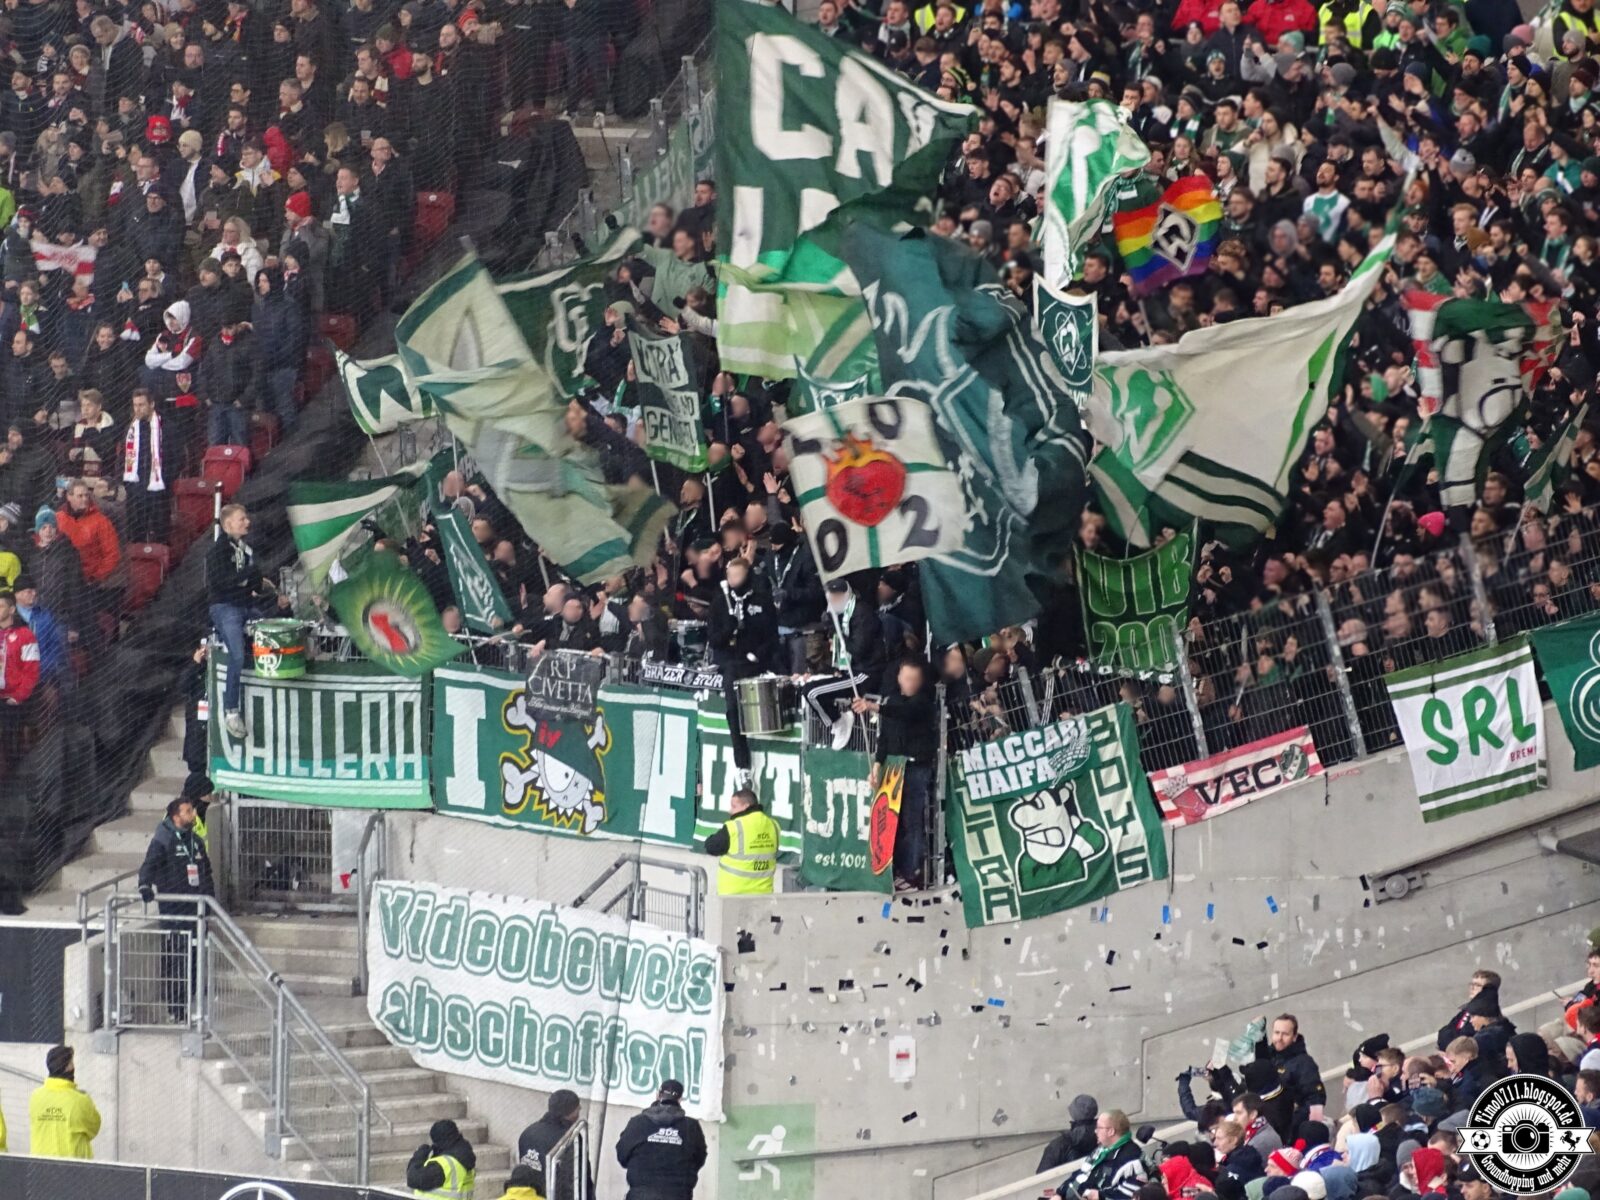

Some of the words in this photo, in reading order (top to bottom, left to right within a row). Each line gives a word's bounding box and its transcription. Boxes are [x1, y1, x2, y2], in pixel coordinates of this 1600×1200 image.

[528, 664, 593, 704] CIVETTA
[644, 664, 686, 683] GRAZER
[216, 681, 422, 781] CAILLERA
[961, 717, 1089, 773] MACCABI
[1421, 677, 1536, 765] SRL
[966, 755, 1058, 801] HAIFA
[1195, 757, 1282, 805] VEC
[814, 851, 838, 867] est.
[379, 884, 717, 1014] Videobeweis
[377, 975, 706, 1105] abschaffen!
